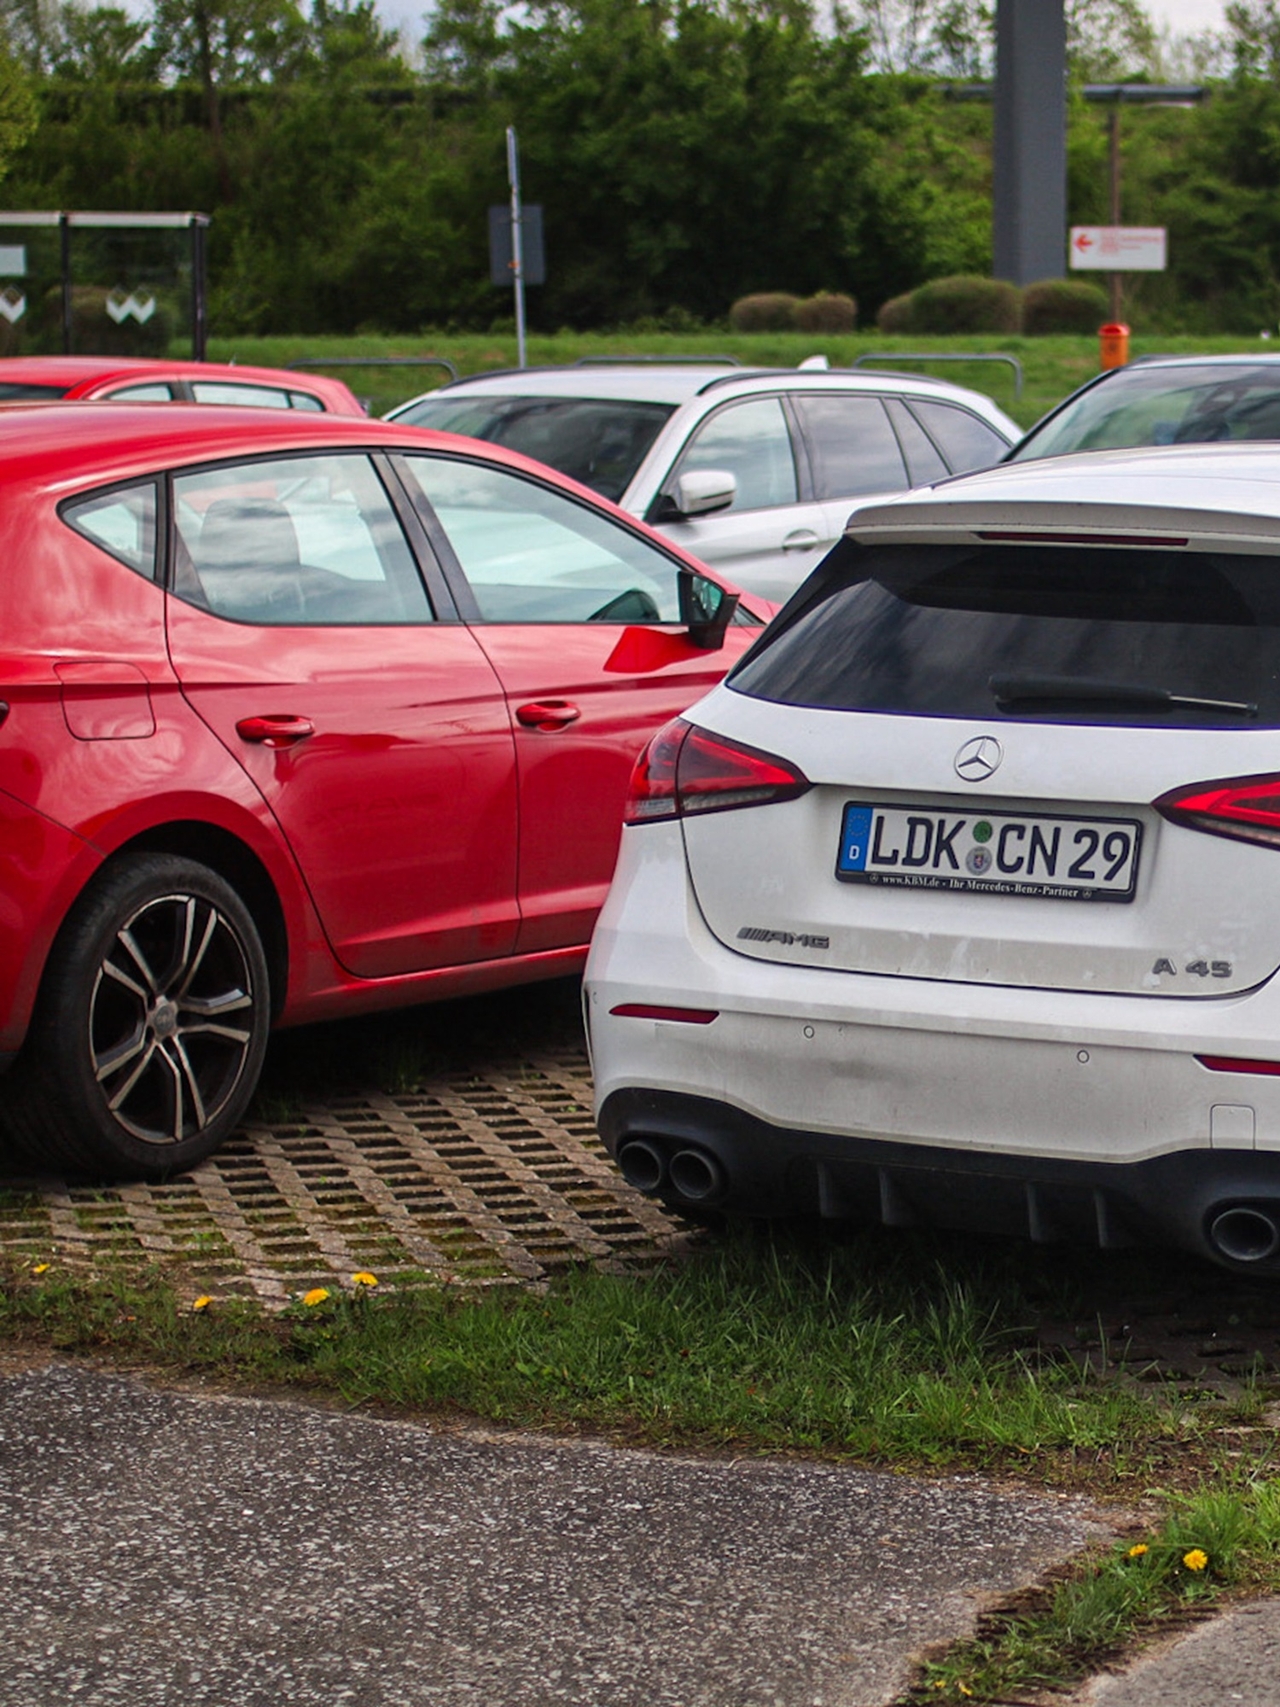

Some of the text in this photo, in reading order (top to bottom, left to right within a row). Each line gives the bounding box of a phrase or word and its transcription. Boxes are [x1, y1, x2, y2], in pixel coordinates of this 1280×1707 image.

[848, 845, 860, 860] D
[871, 815, 1132, 882] LDK CN 29
[882, 874, 940, 888] www.KBM.de
[949, 878, 964, 890] Ihr
[966, 880, 1080, 898] Mercedes-Benz-Partner
[1152, 958, 1232, 978] A 45
